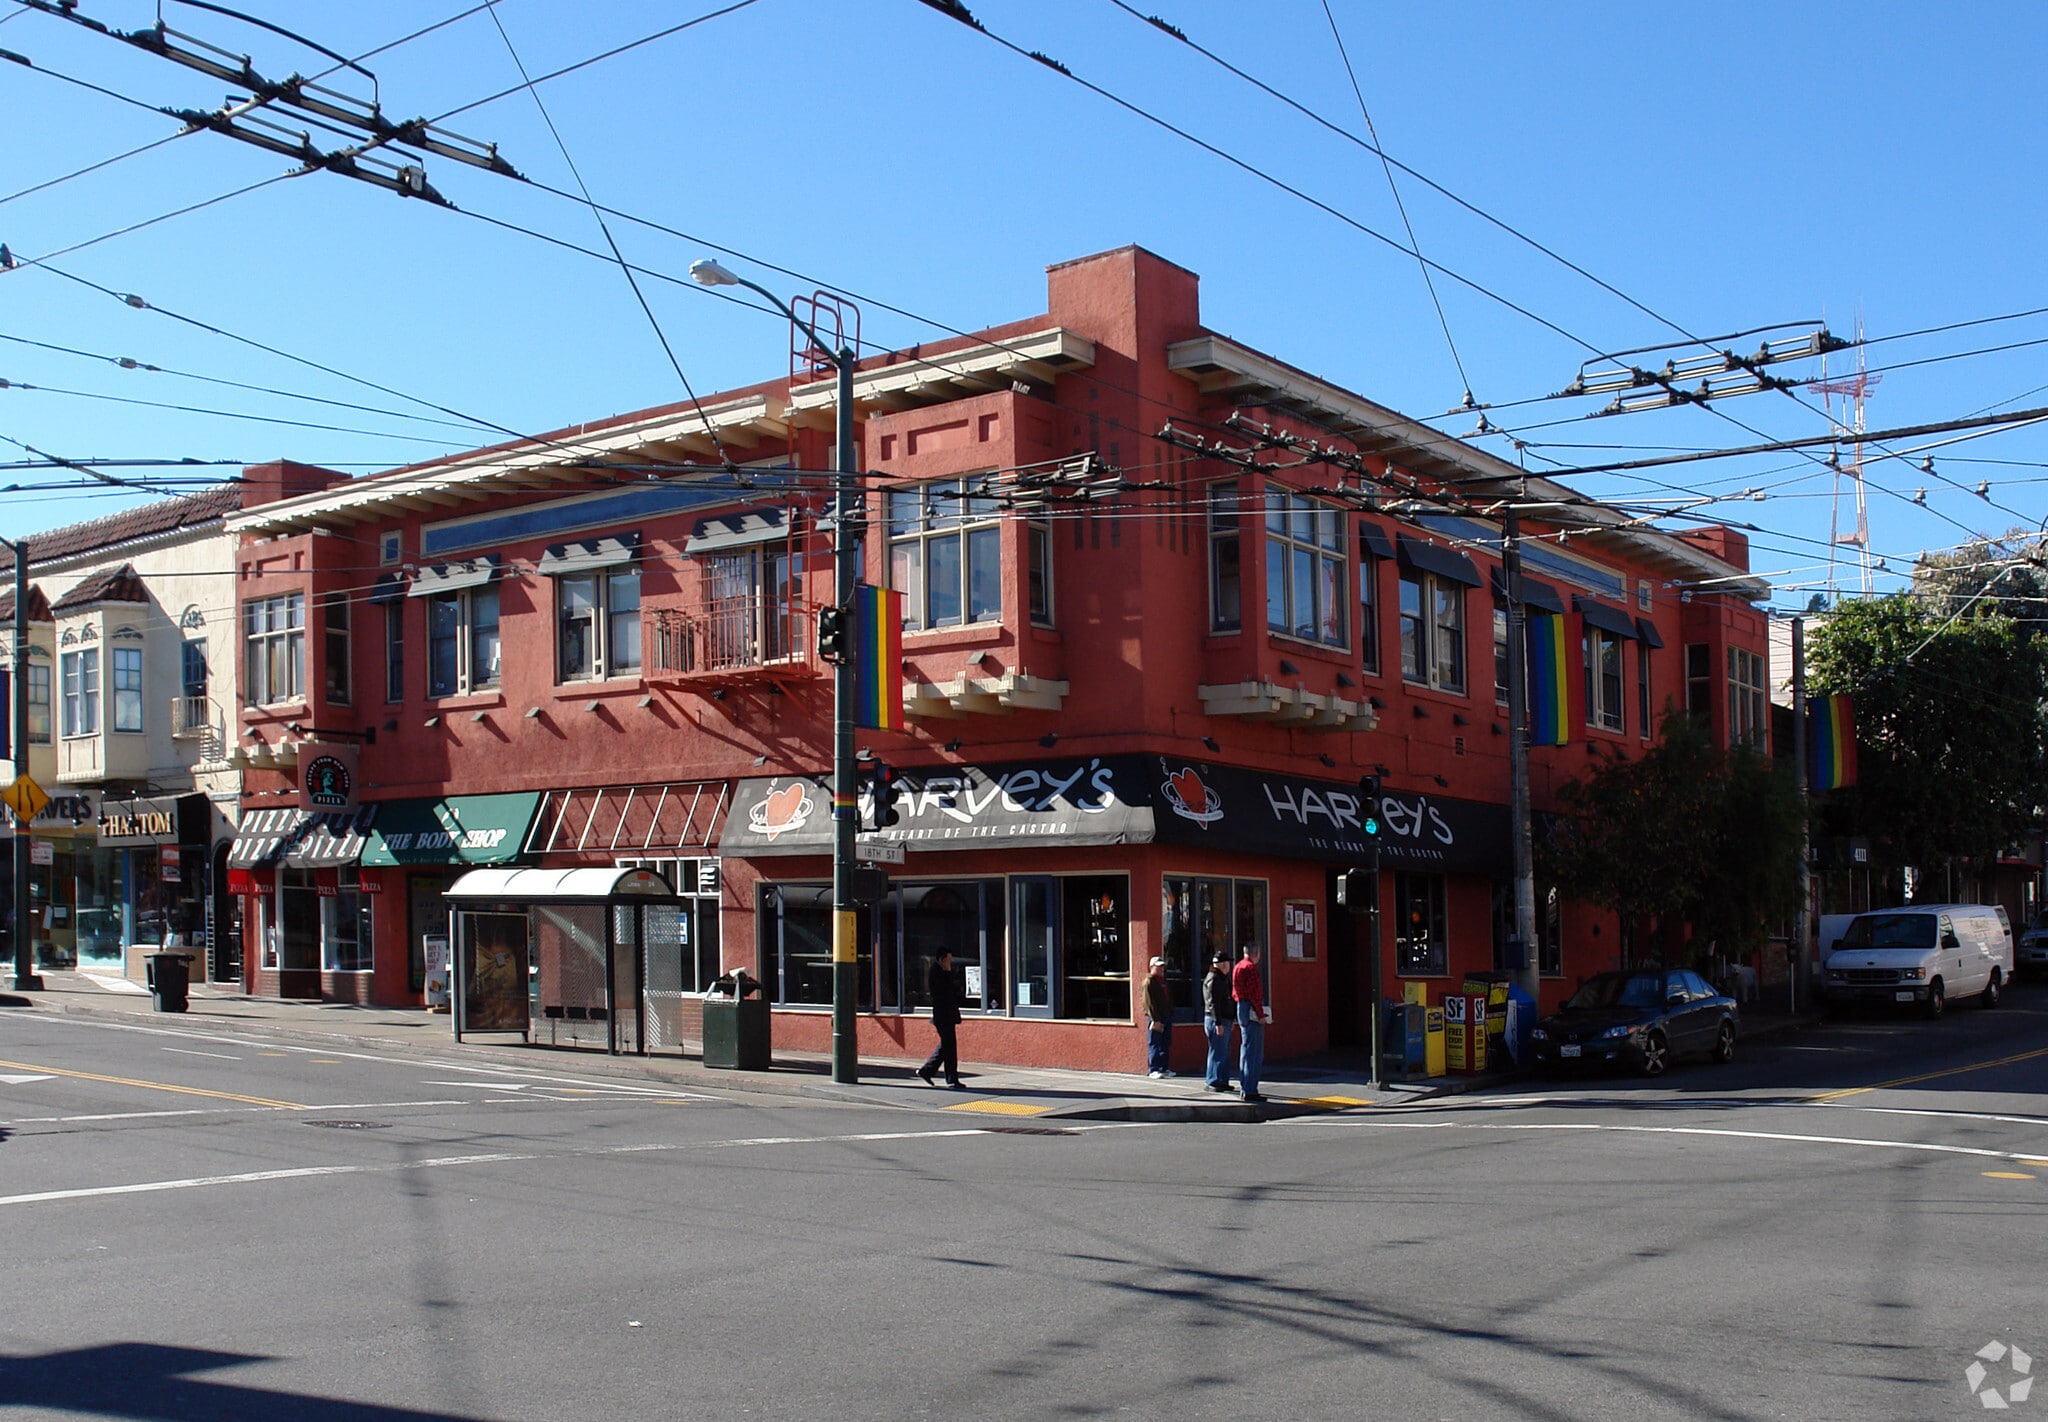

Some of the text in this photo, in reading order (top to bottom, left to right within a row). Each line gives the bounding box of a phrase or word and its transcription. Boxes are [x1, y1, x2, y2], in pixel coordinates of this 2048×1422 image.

[317, 796, 341, 805] PIZZA
[239, 808, 302, 833] PIZZA
[380, 829, 507, 851] THE BODY SHOP
[888, 828, 934, 842] HEART
[944, 827, 961, 838] OF
[971, 826, 997, 837] THE
[1009, 823, 1068, 836] CASTRO
[227, 836, 290, 861] PIZZA
[298, 833, 366, 859] PIZZA
[864, 847, 896, 859] 18TH ST
[1854, 847, 1867, 862] 4111
[1447, 998, 1464, 1019] SF
[1475, 999, 1484, 1019] SF
